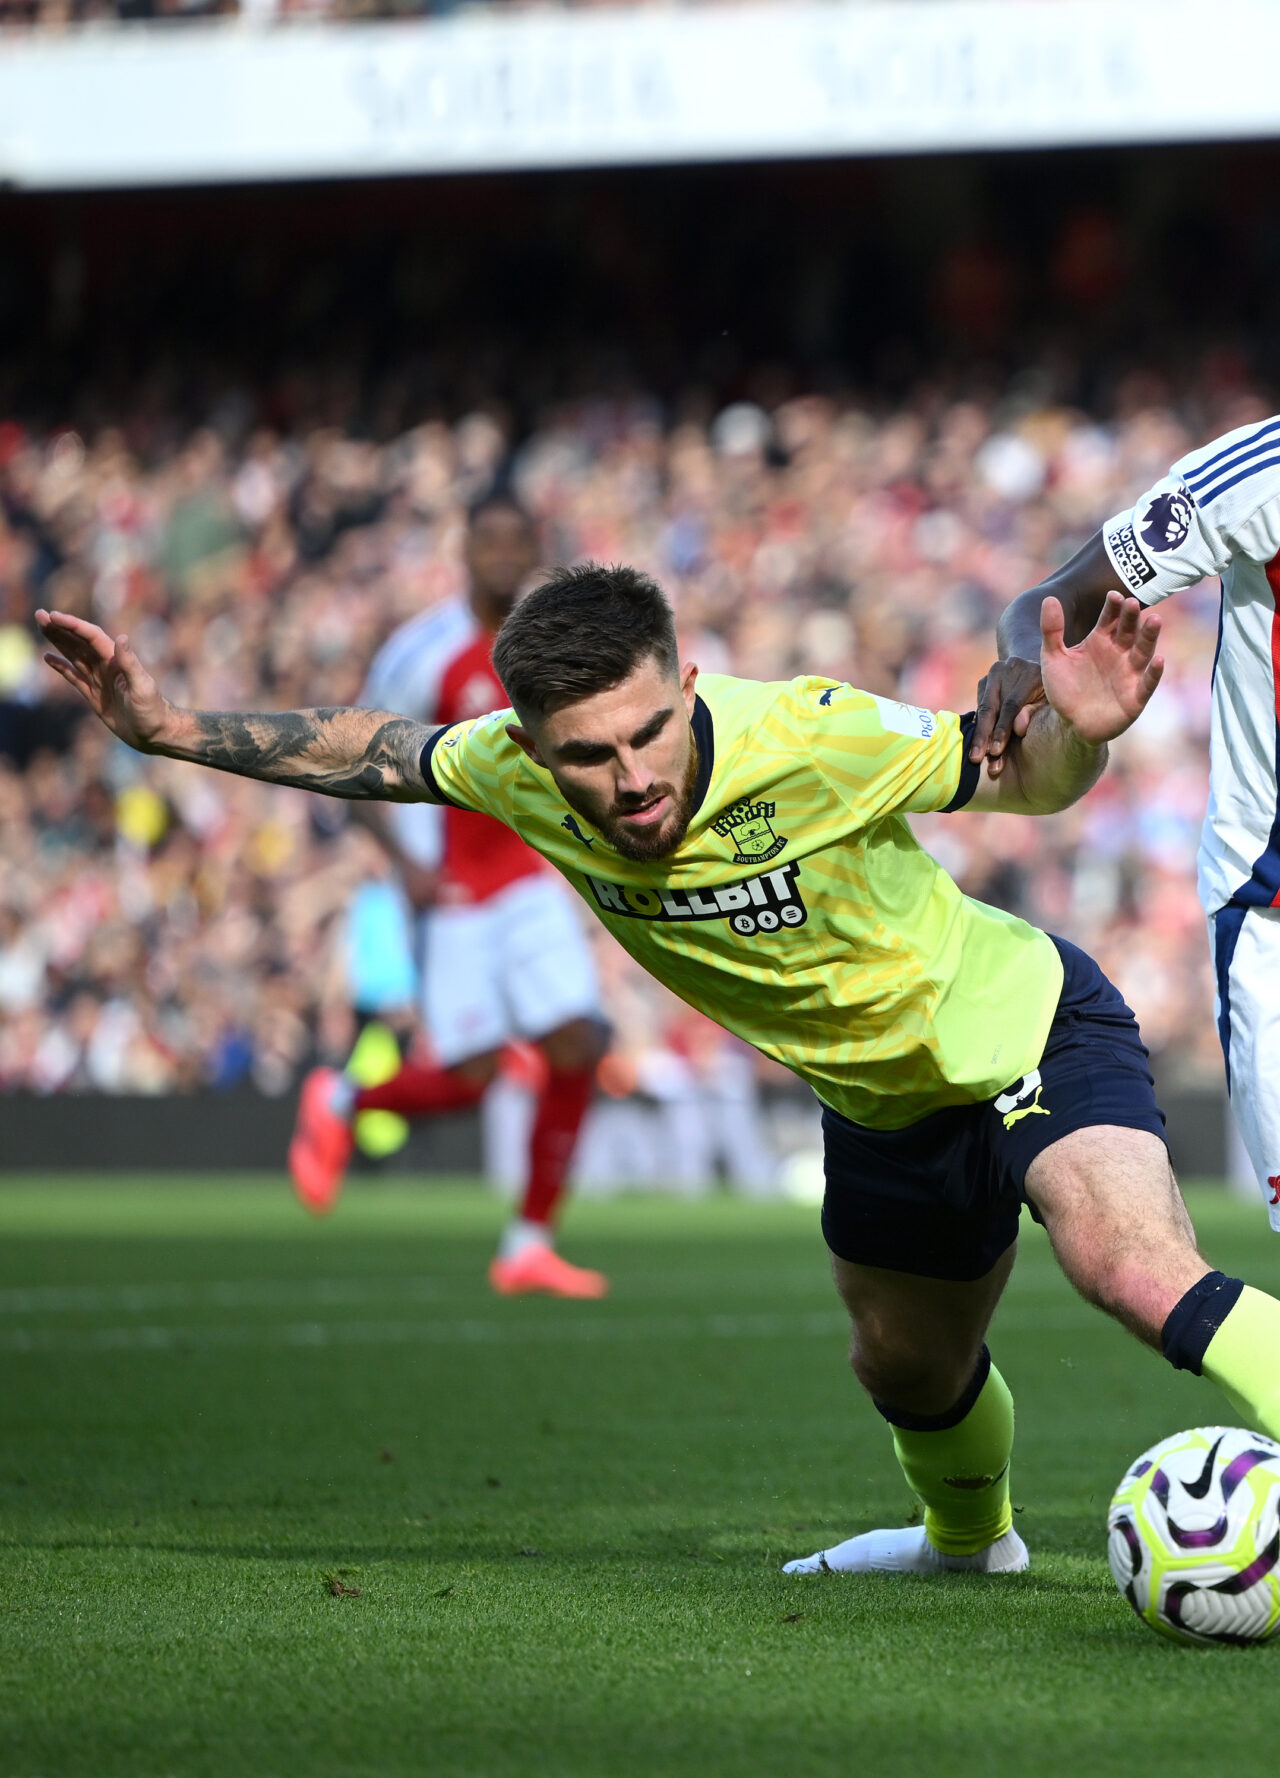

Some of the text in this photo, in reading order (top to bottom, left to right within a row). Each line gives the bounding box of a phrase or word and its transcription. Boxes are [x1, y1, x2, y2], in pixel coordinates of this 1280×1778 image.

[1113, 545, 1144, 589] racism
[1123, 540, 1150, 577] room
[736, 846, 779, 863] SOUTHAMPTON
[591, 865, 791, 916] ROLLBIT
